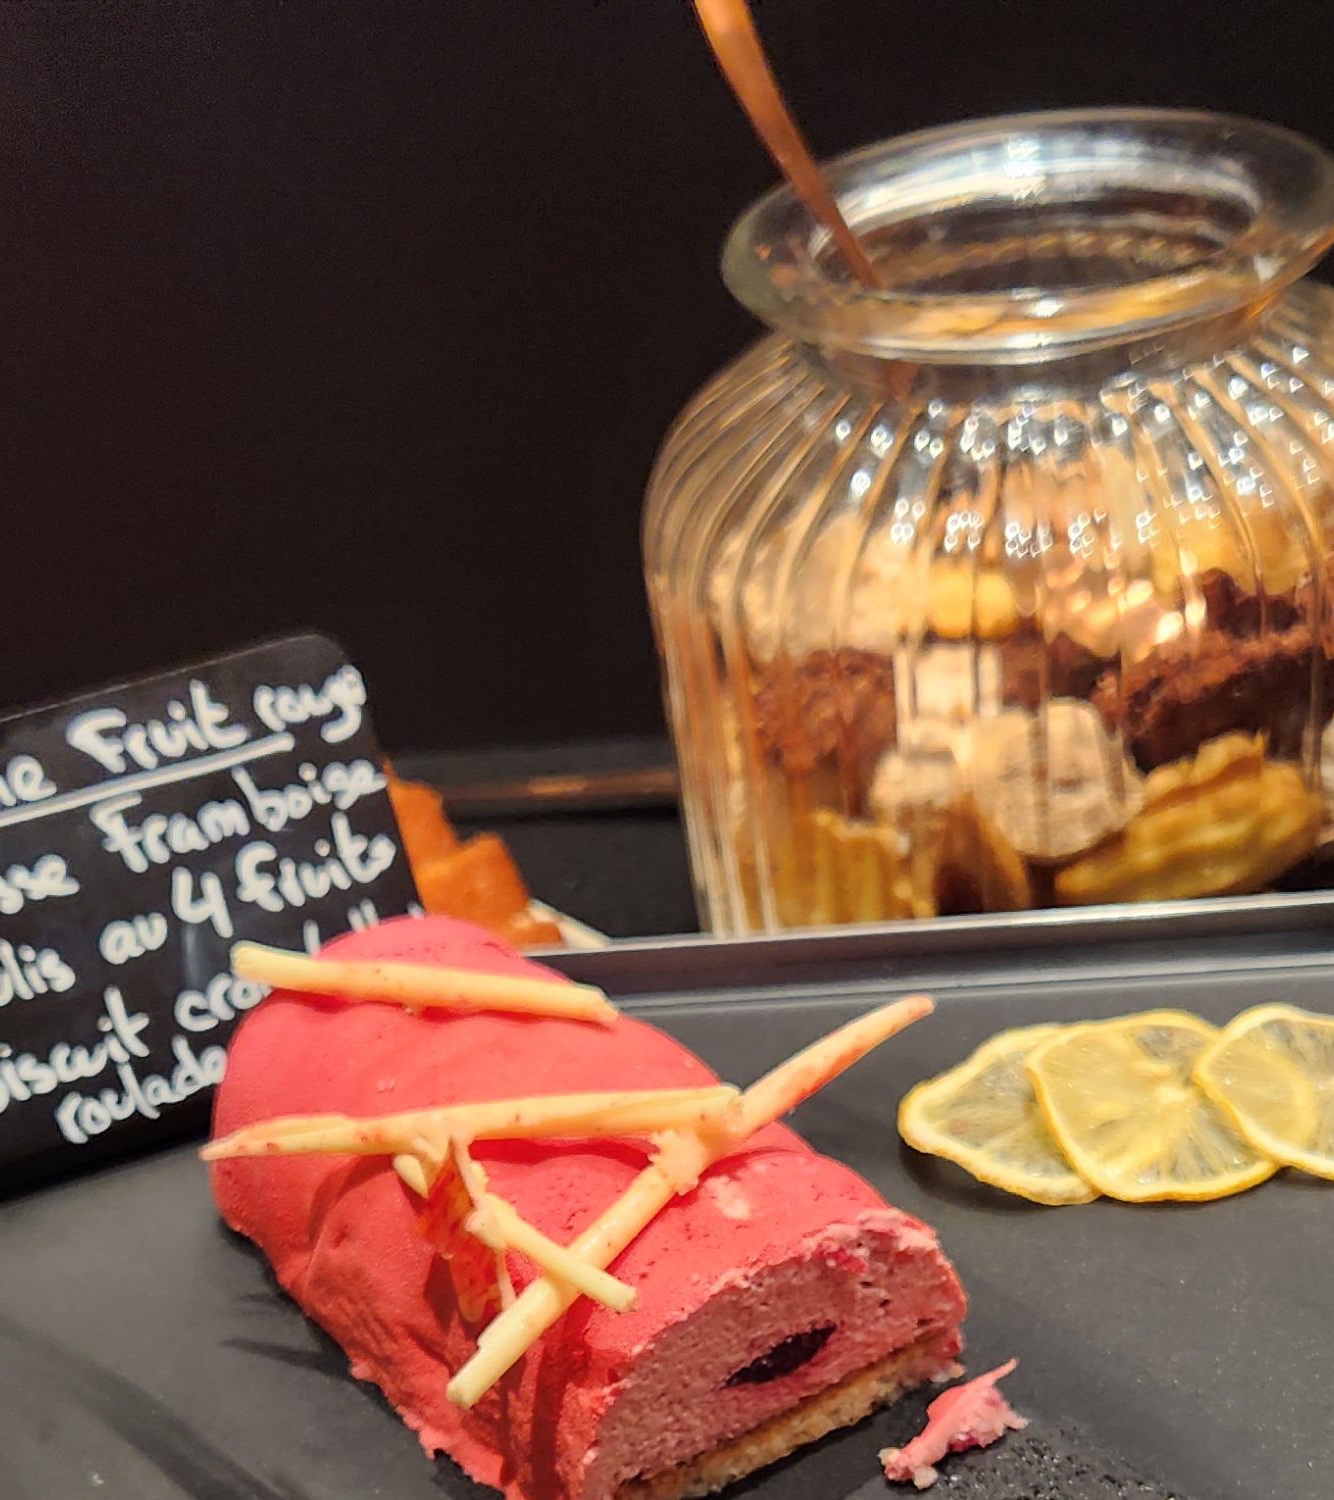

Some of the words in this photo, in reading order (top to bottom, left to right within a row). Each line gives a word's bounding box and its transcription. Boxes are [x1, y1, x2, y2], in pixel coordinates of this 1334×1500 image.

[70, 680, 249, 772] Fruit
[91, 760, 388, 873] Framboise
[99, 911, 168, 966] au
[171, 867, 235, 939] 4
